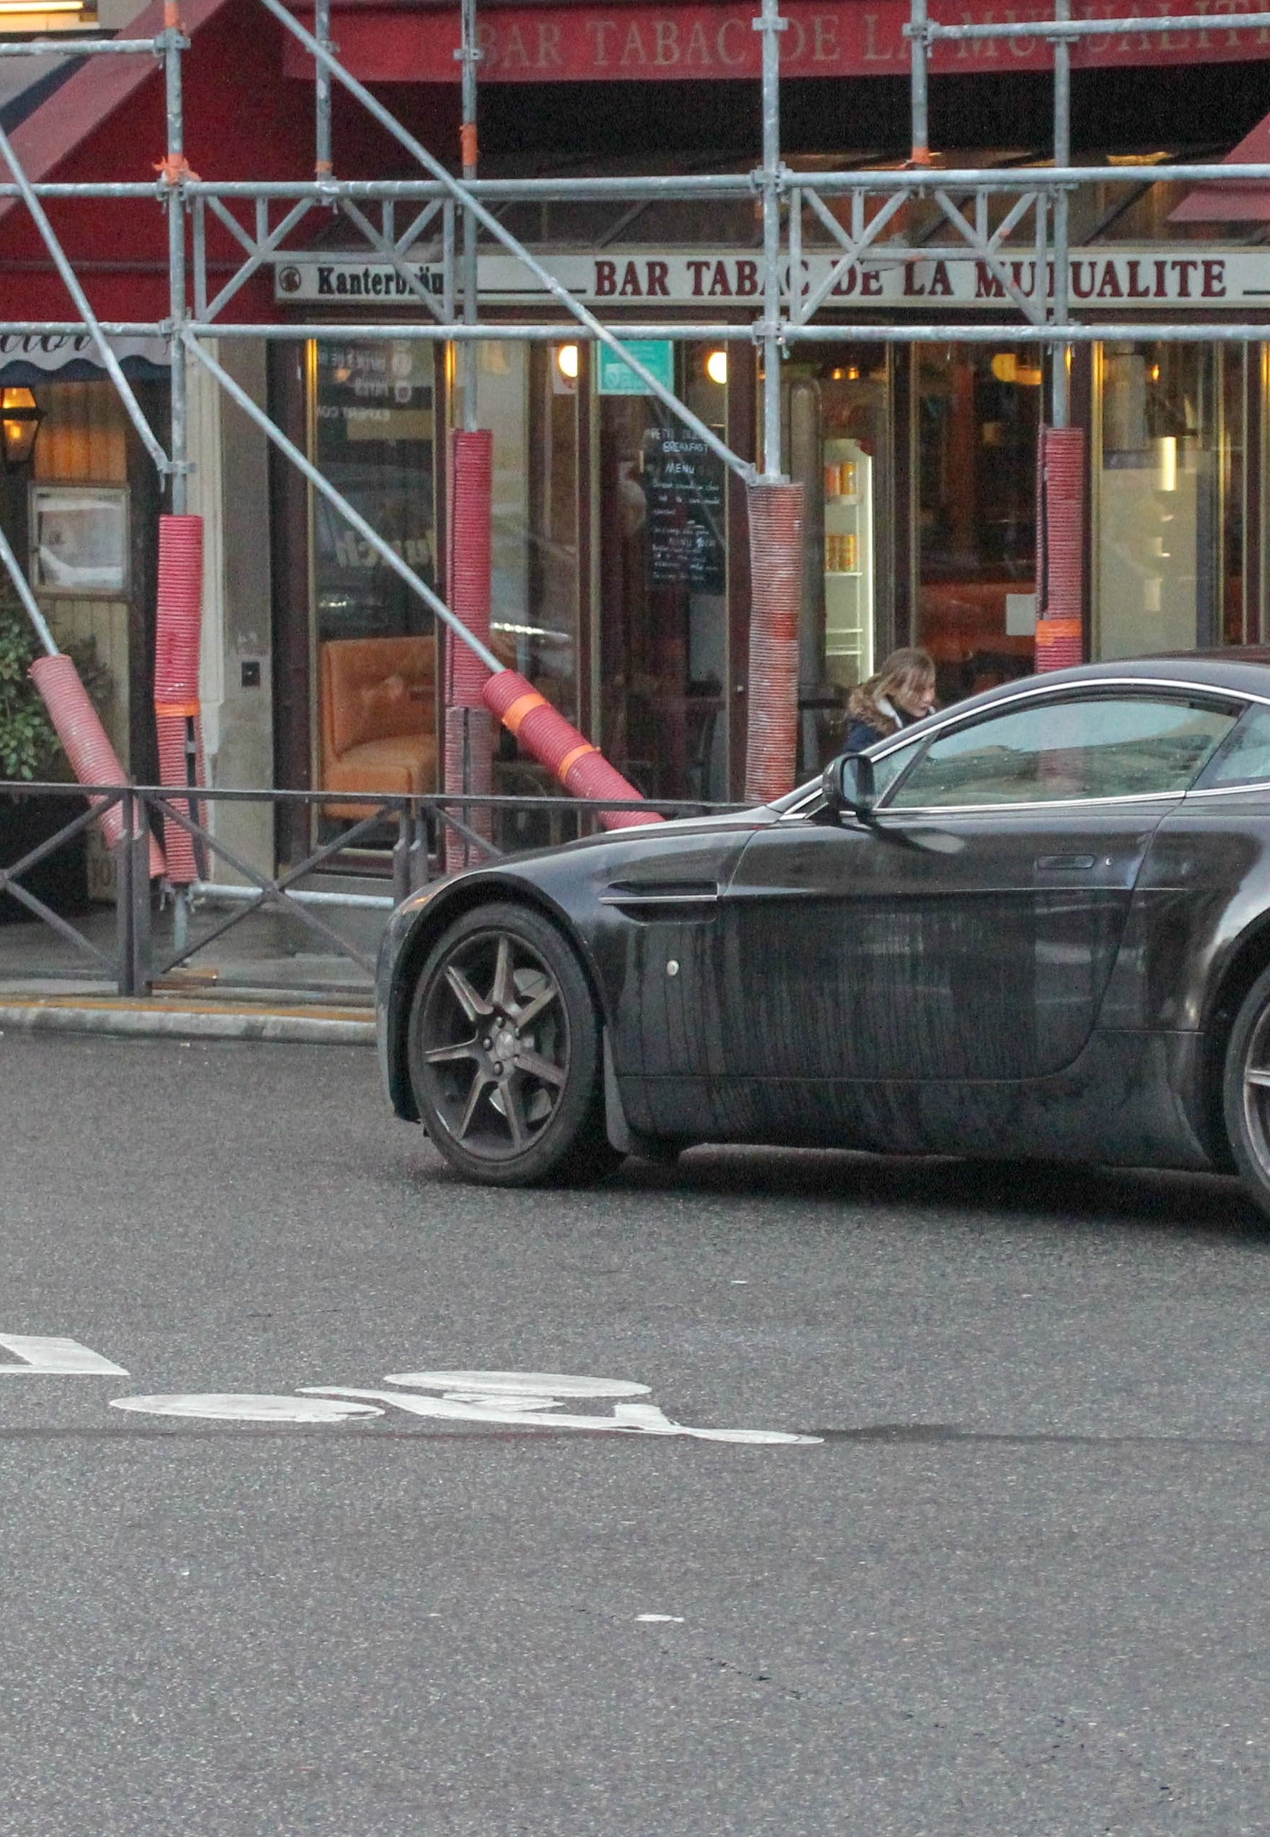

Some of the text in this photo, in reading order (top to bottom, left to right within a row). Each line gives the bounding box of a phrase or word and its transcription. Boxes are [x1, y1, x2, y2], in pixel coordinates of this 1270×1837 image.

[586, 17, 746, 67] TABAC
[594, 260, 670, 297] BAR
[830, 260, 883, 297] DE
[903, 260, 954, 297] LA
[664, 463, 695, 474] MENU
